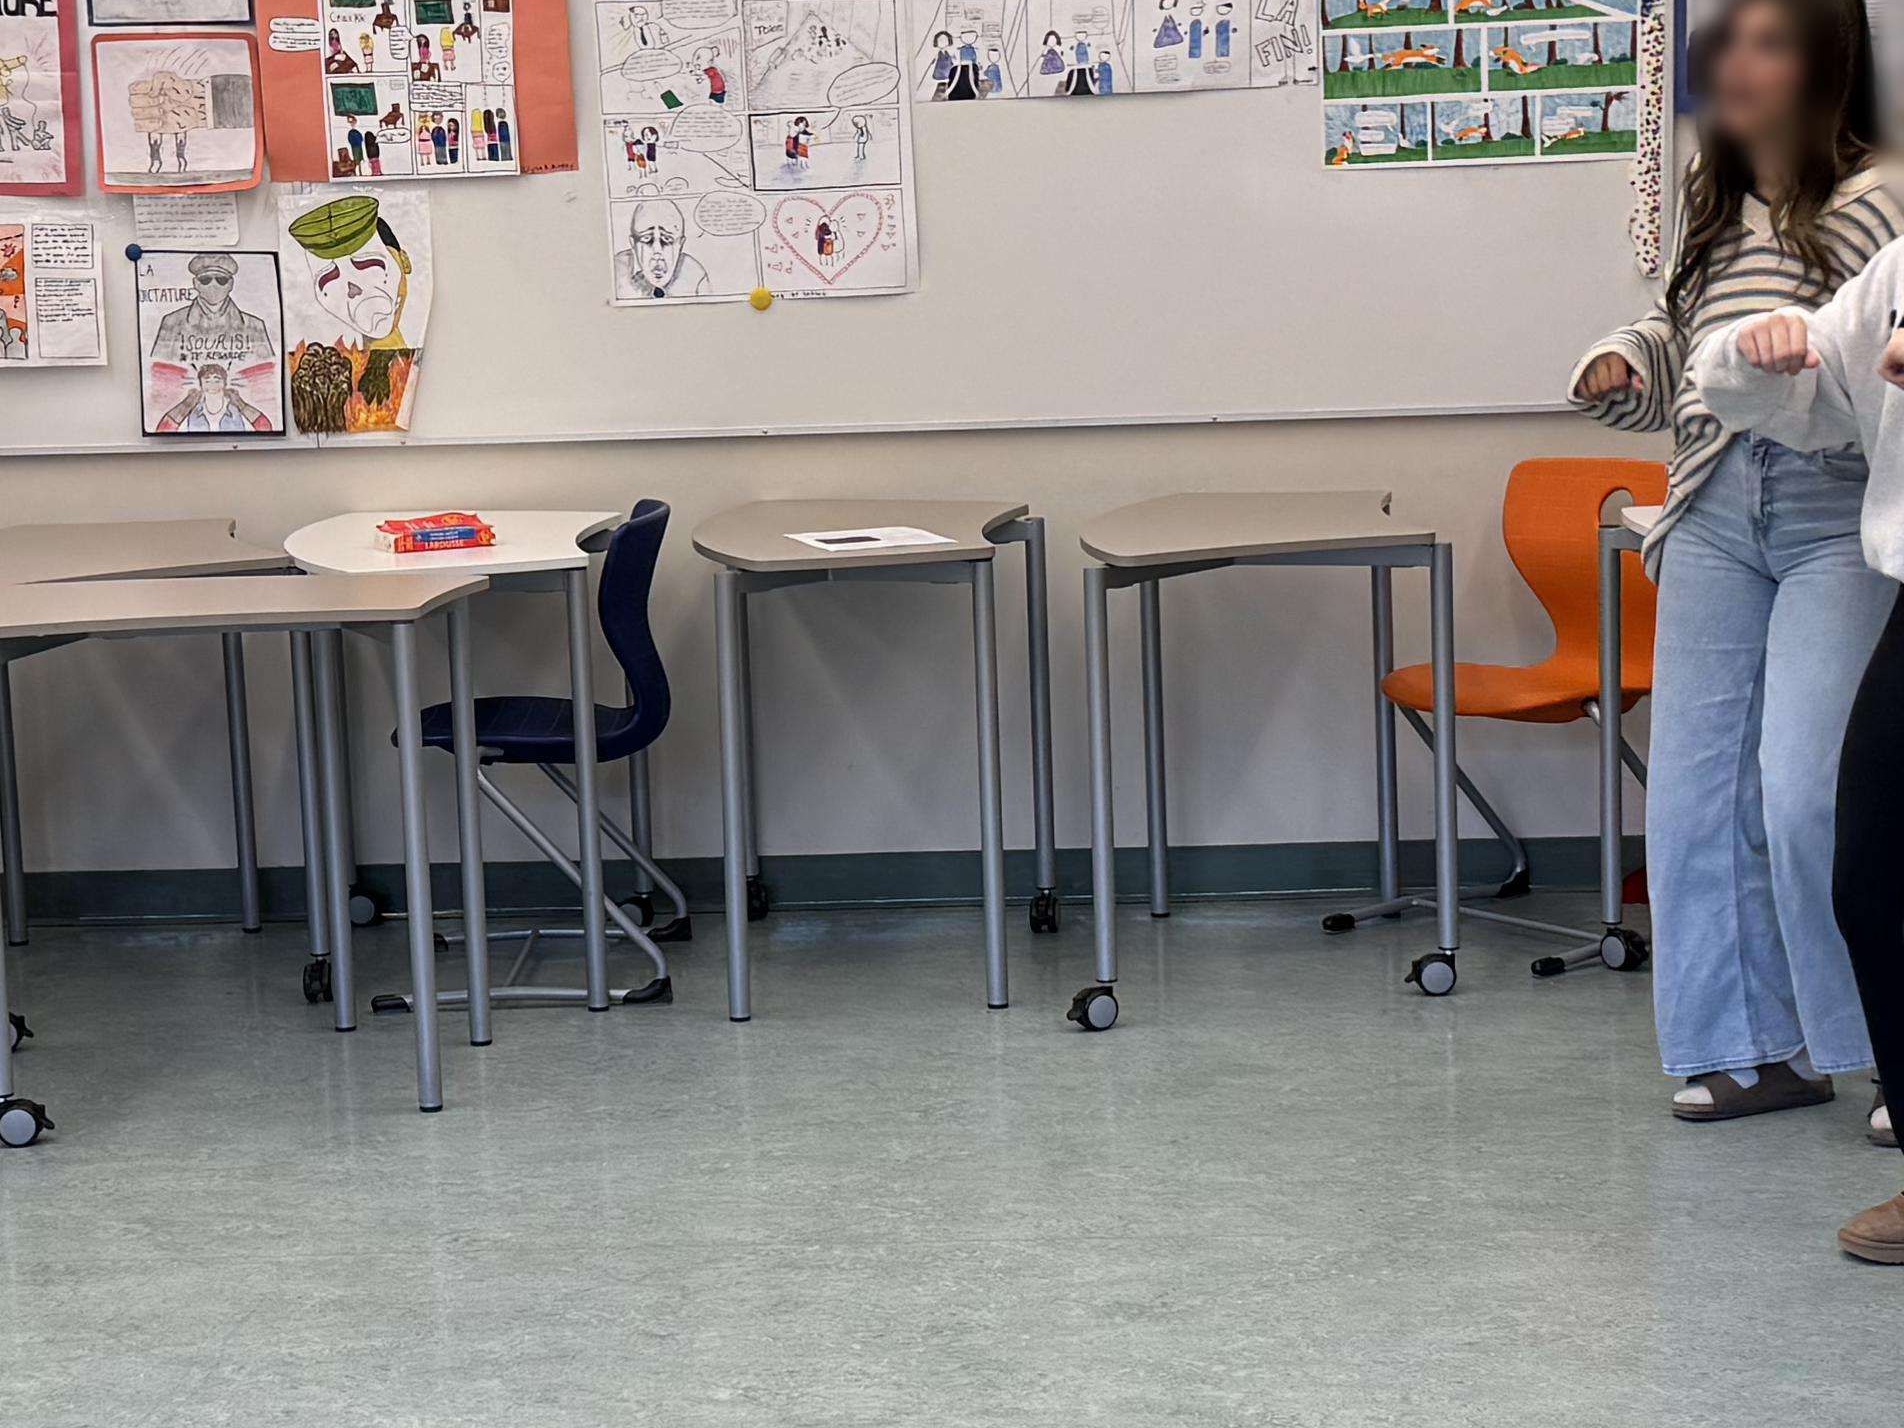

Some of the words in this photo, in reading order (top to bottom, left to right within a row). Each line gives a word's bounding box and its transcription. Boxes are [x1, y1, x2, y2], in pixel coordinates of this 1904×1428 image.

[1255, 24, 1314, 68] FIN!
[138, 286, 198, 303] DICTATURE
[424, 540, 465, 551] LAROUSSE
